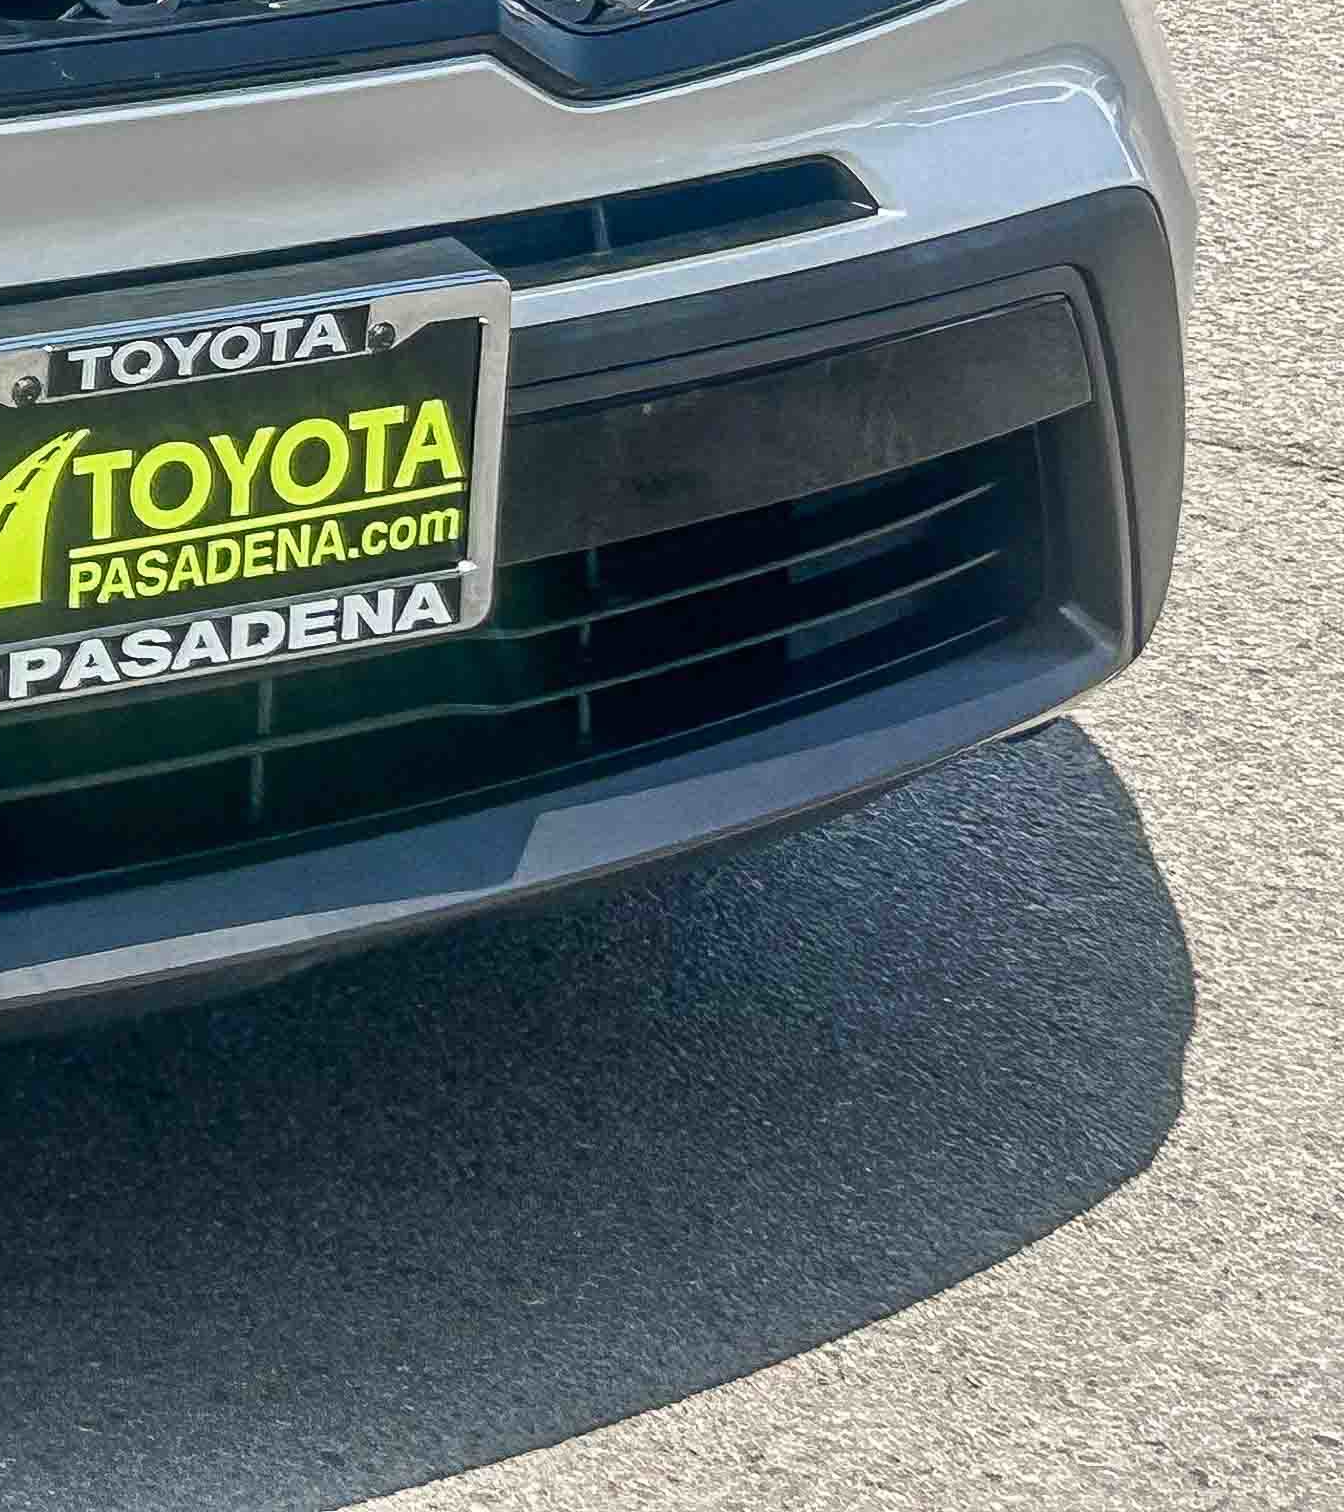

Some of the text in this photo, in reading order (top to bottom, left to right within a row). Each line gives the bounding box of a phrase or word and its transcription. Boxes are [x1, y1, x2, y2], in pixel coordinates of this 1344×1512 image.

[68, 313, 348, 390] TOYOTA
[72, 399, 465, 540] TOYOTA
[68, 506, 461, 609] PASADENA.com
[8, 582, 454, 699] PASADENA
